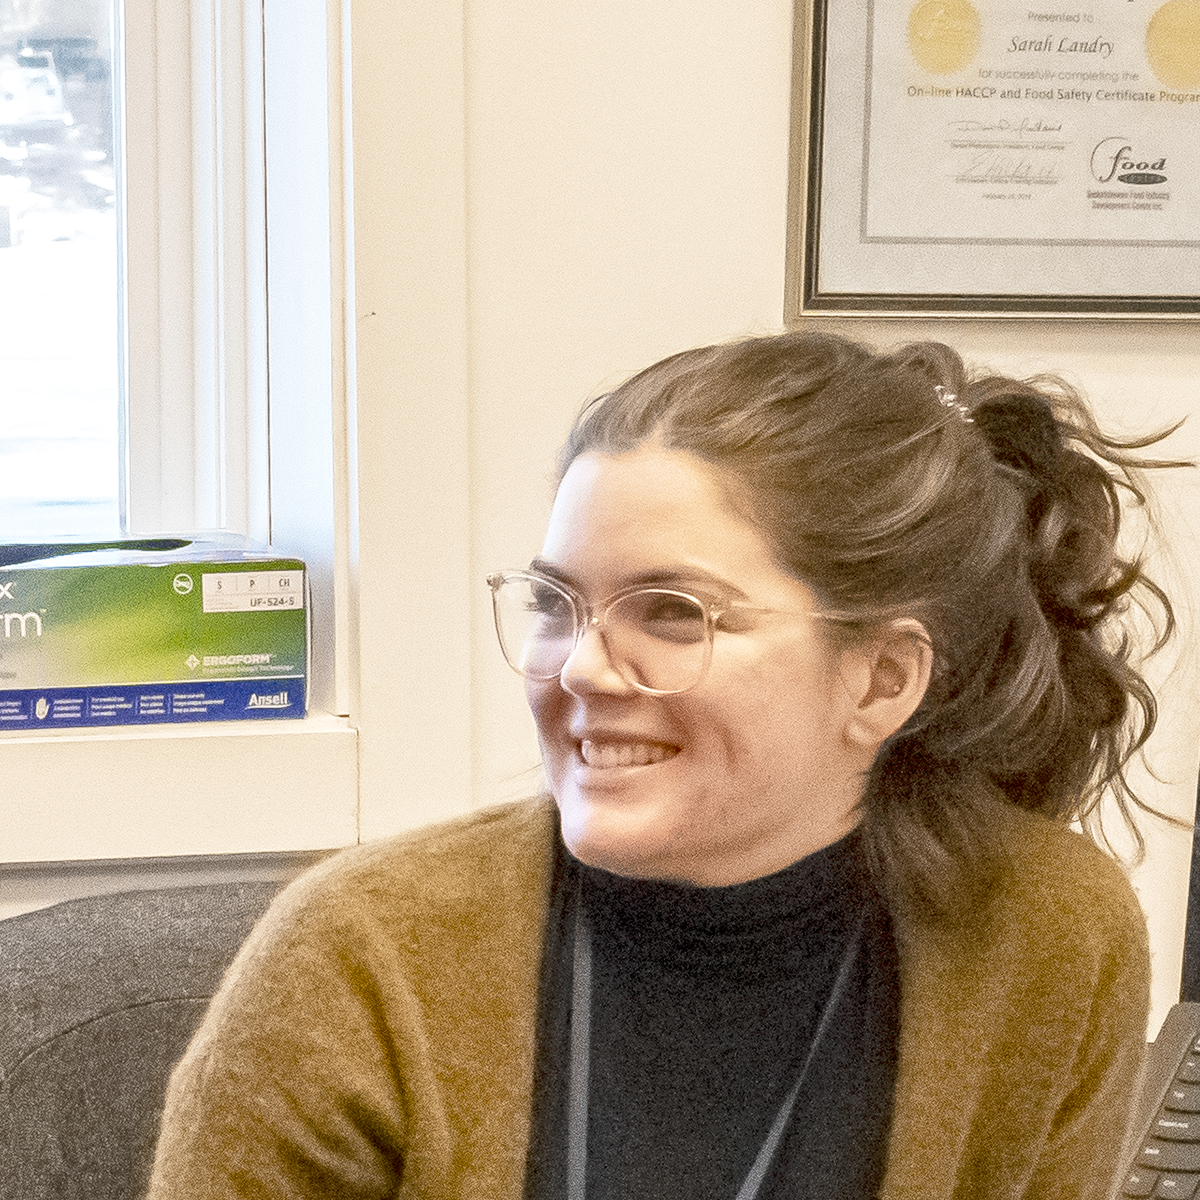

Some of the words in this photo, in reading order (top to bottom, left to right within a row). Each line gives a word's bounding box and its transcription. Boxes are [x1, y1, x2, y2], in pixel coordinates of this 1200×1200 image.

[1028, 11, 1080, 23] Presented
[1083, 12, 1094, 23] to
[1007, 34, 1053, 53] Sarah
[1056, 35, 1114, 59] Landry
[978, 68, 992, 79] for
[995, 68, 1055, 82] successfully
[1057, 70, 1119, 83] completing
[1121, 71, 1140, 82] the
[907, 85, 952, 98] On-line
[955, 87, 997, 99] HACCP
[1000, 88, 1021, 99] and
[1024, 89, 1054, 100] Food
[1057, 89, 1093, 103] Safety
[1095, 90, 1156, 102] Certificate
[1096, 144, 1168, 183] food
[217, 580, 223, 590] S
[249, 579, 256, 588] P
[278, 578, 290, 588] CH
[249, 596, 295, 608] UF-524-S
[203, 653, 271, 666] ERGOFORM
[248, 691, 289, 707] Ansell
